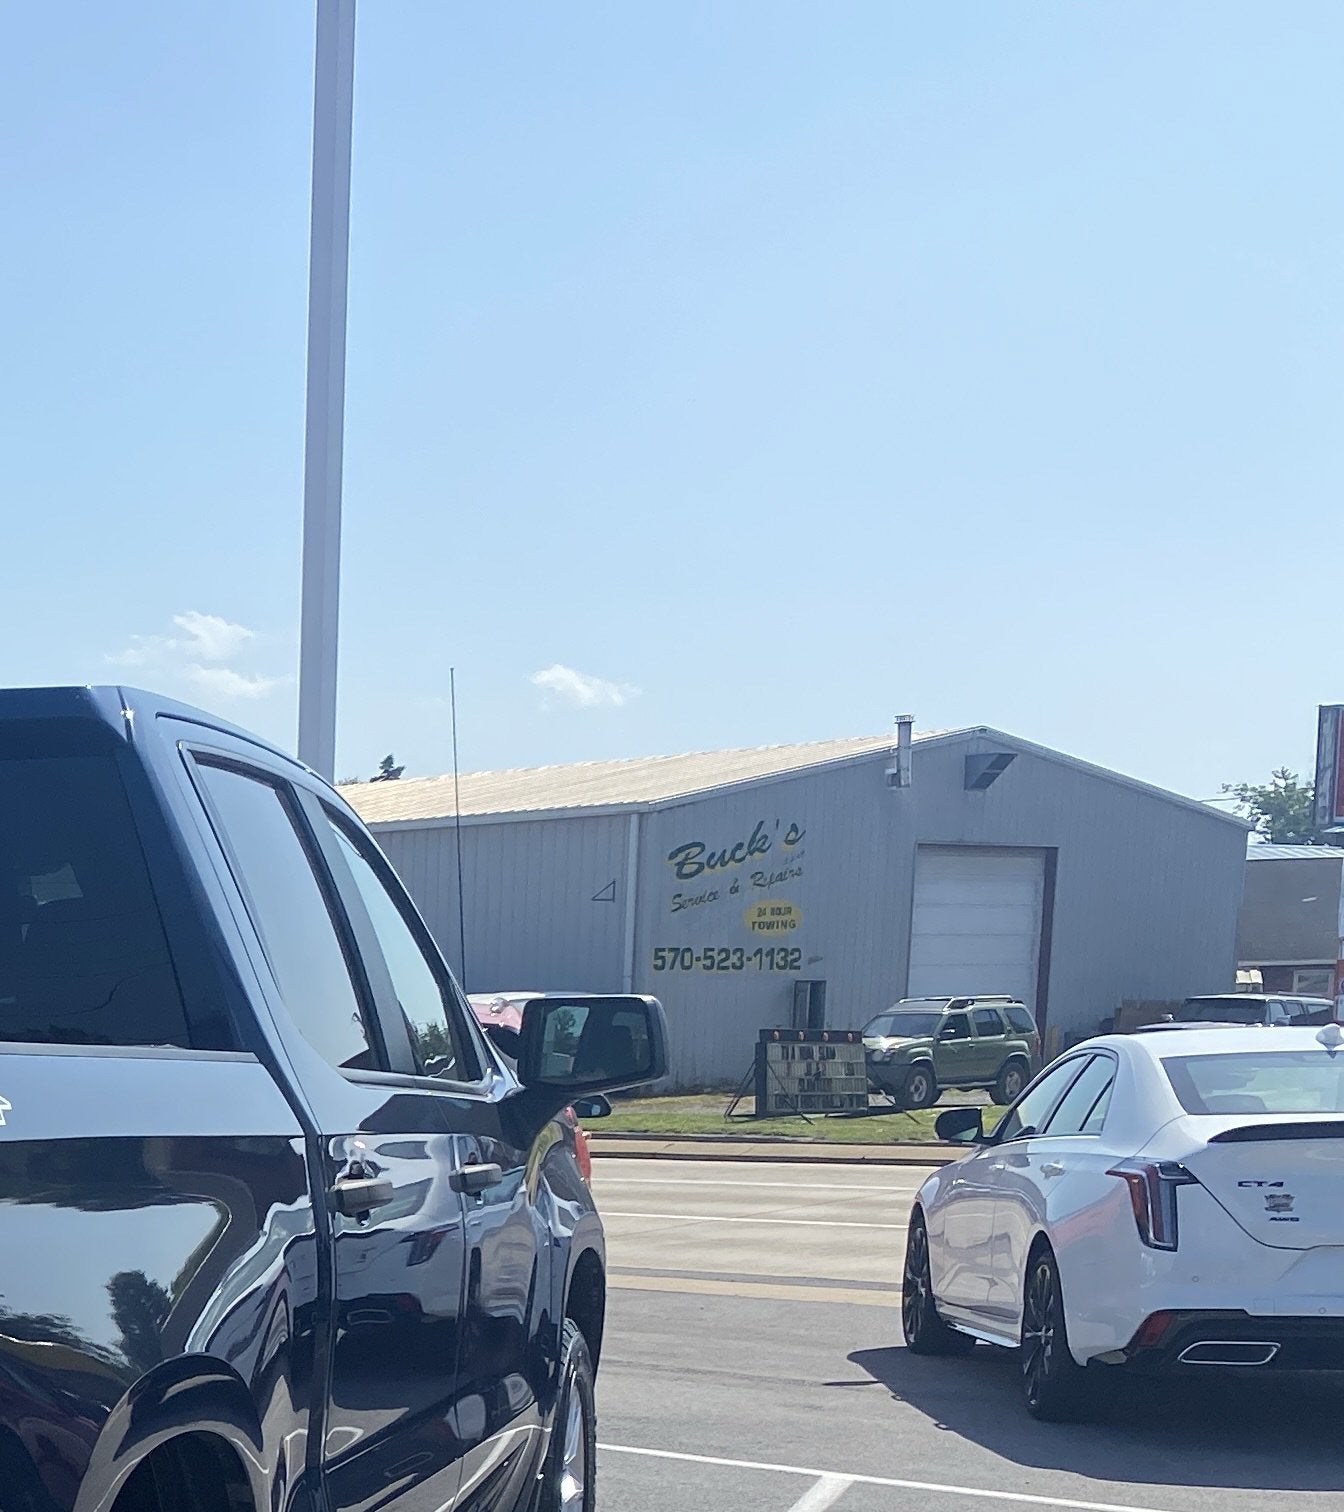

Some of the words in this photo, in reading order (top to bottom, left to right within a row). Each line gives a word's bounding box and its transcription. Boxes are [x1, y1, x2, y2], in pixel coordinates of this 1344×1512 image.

[667, 818, 807, 880] Buck's
[670, 889, 721, 913] Service
[749, 866, 804, 890] Repairs
[756, 906, 768, 918] 24
[770, 906, 793, 917] HOUR
[750, 920, 797, 931] TOWING
[652, 947, 802, 971] 570-523-1132
[1237, 1180, 1284, 1188] CT4
